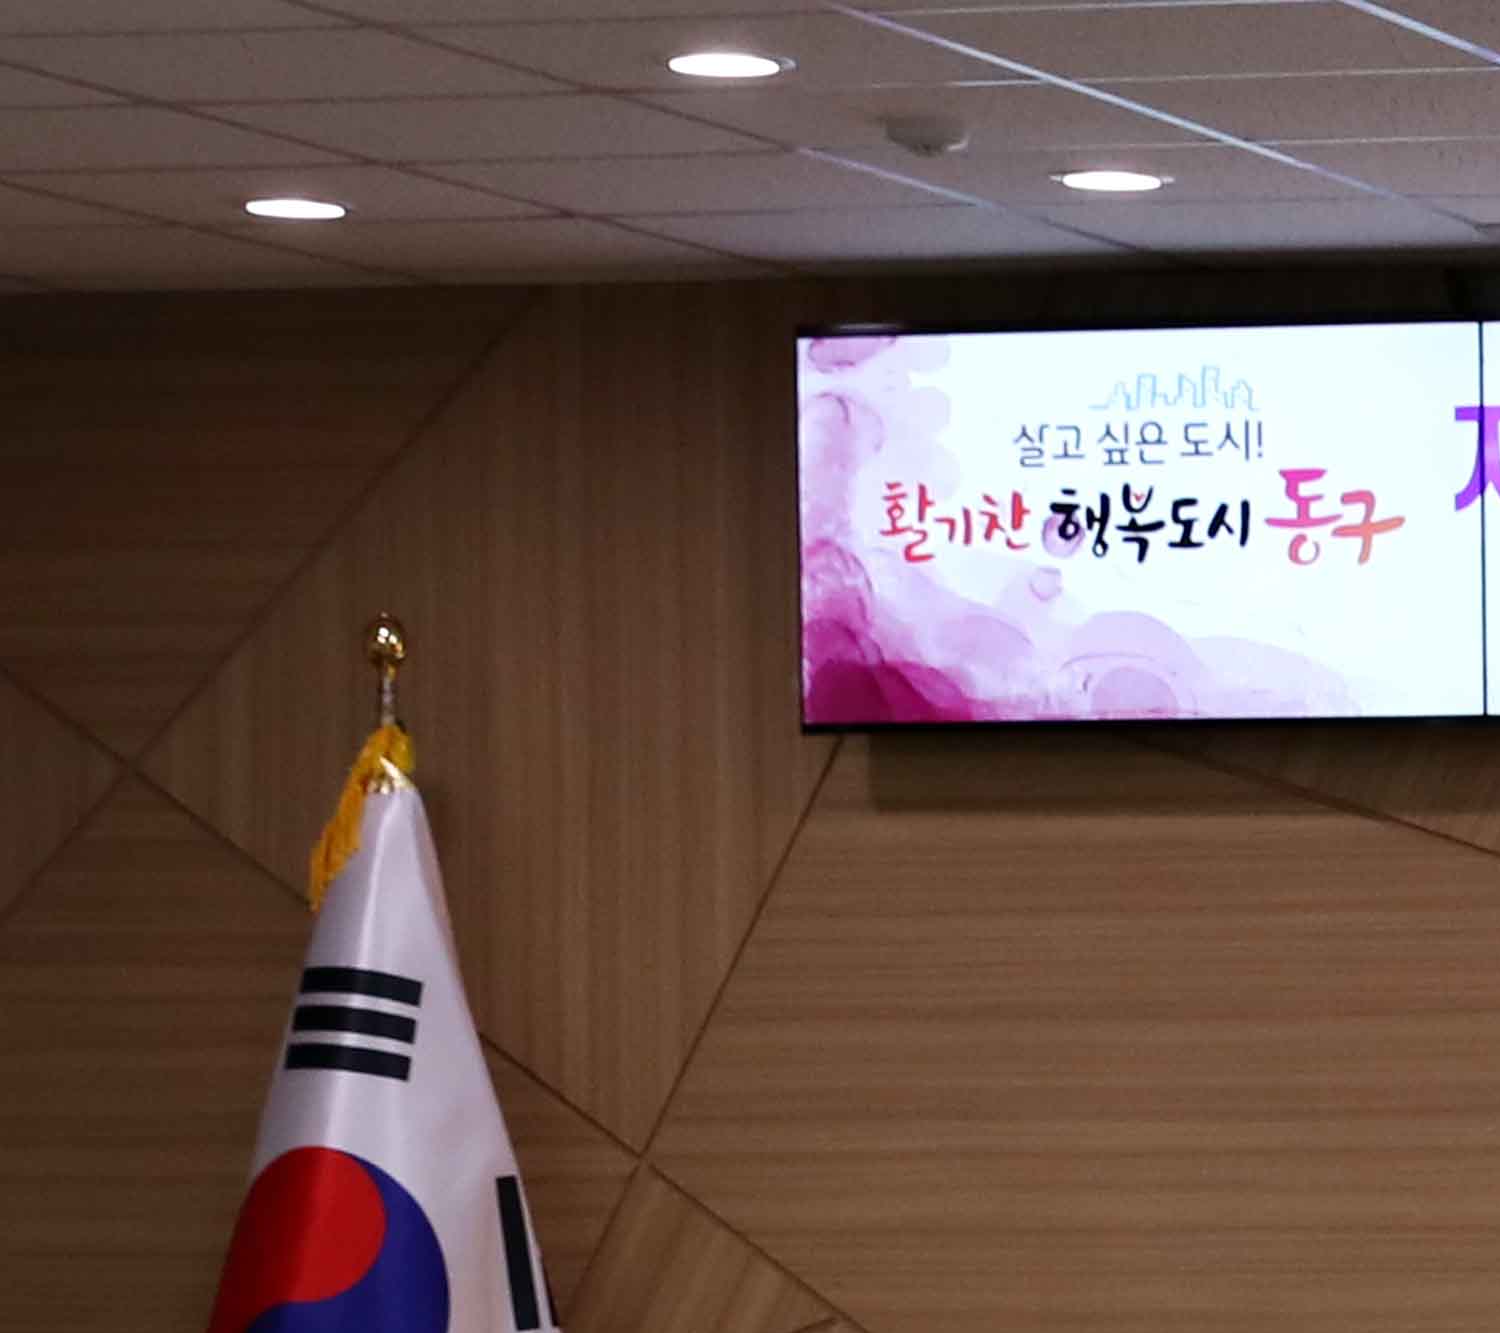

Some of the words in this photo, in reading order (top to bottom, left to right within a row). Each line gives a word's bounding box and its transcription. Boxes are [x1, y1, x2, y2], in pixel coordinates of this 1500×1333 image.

[1012, 421, 1086, 469] 살고
[1096, 420, 1168, 467] 싶은
[1179, 419, 1265, 461] 도시!
[880, 481, 1031, 563] 활기찬
[1049, 482, 1251, 564] 행복도시
[1263, 468, 1407, 565] 동구
